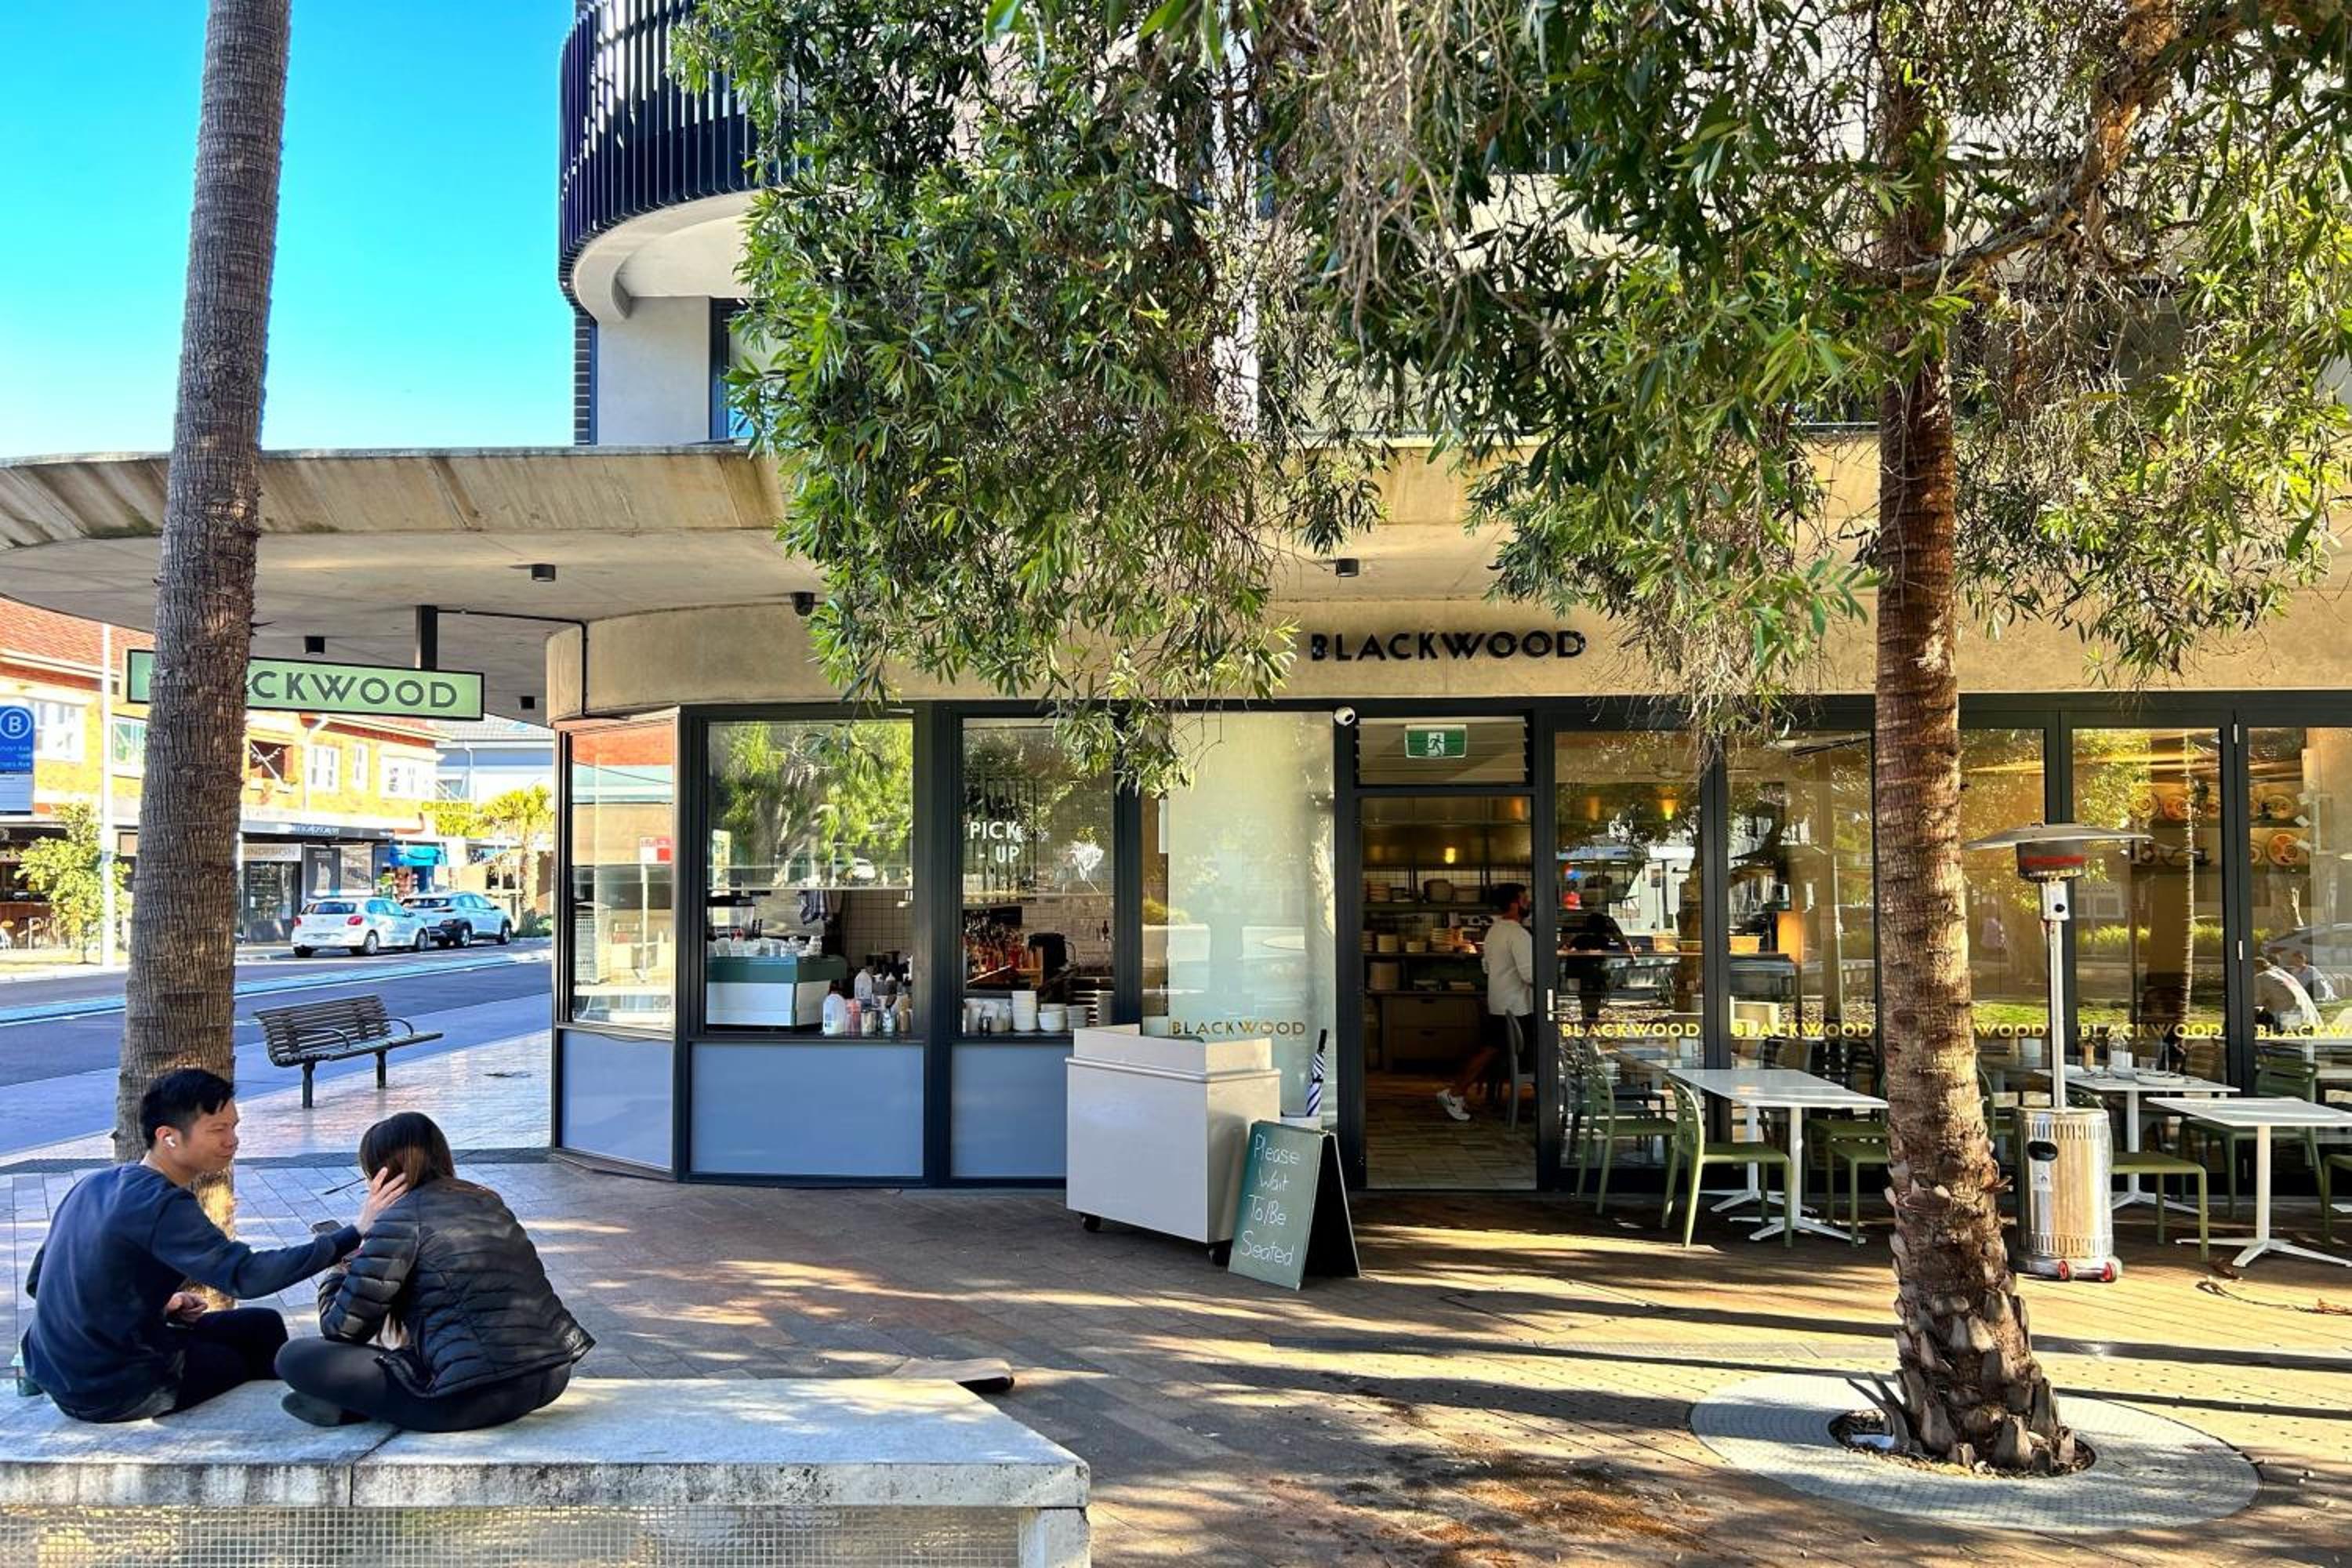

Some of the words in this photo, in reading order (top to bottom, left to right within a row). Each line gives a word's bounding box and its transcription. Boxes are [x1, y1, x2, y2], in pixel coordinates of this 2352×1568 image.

[1311, 630, 1586, 661] BLACKWOOD
[251, 671, 457, 708] CKWOOD
[9, 716, 22, 732] B
[421, 802, 473, 812] CHEMIST
[969, 821, 1020, 840] PICK
[996, 846, 1019, 863] UP
[1172, 1022, 1305, 1034] BLACKWOOD
[1562, 1022, 1700, 1037] BLACKWOOD
[1733, 1022, 1872, 1038] BLACKWOOD
[2080, 1022, 2223, 1039] BLACKWOOD
[2257, 1023, 2352, 1039] BLACKW
[1254, 1134, 1300, 1164] Please
[1258, 1166, 1290, 1192] Wait
[1242, 1230, 1294, 1267] Seated
